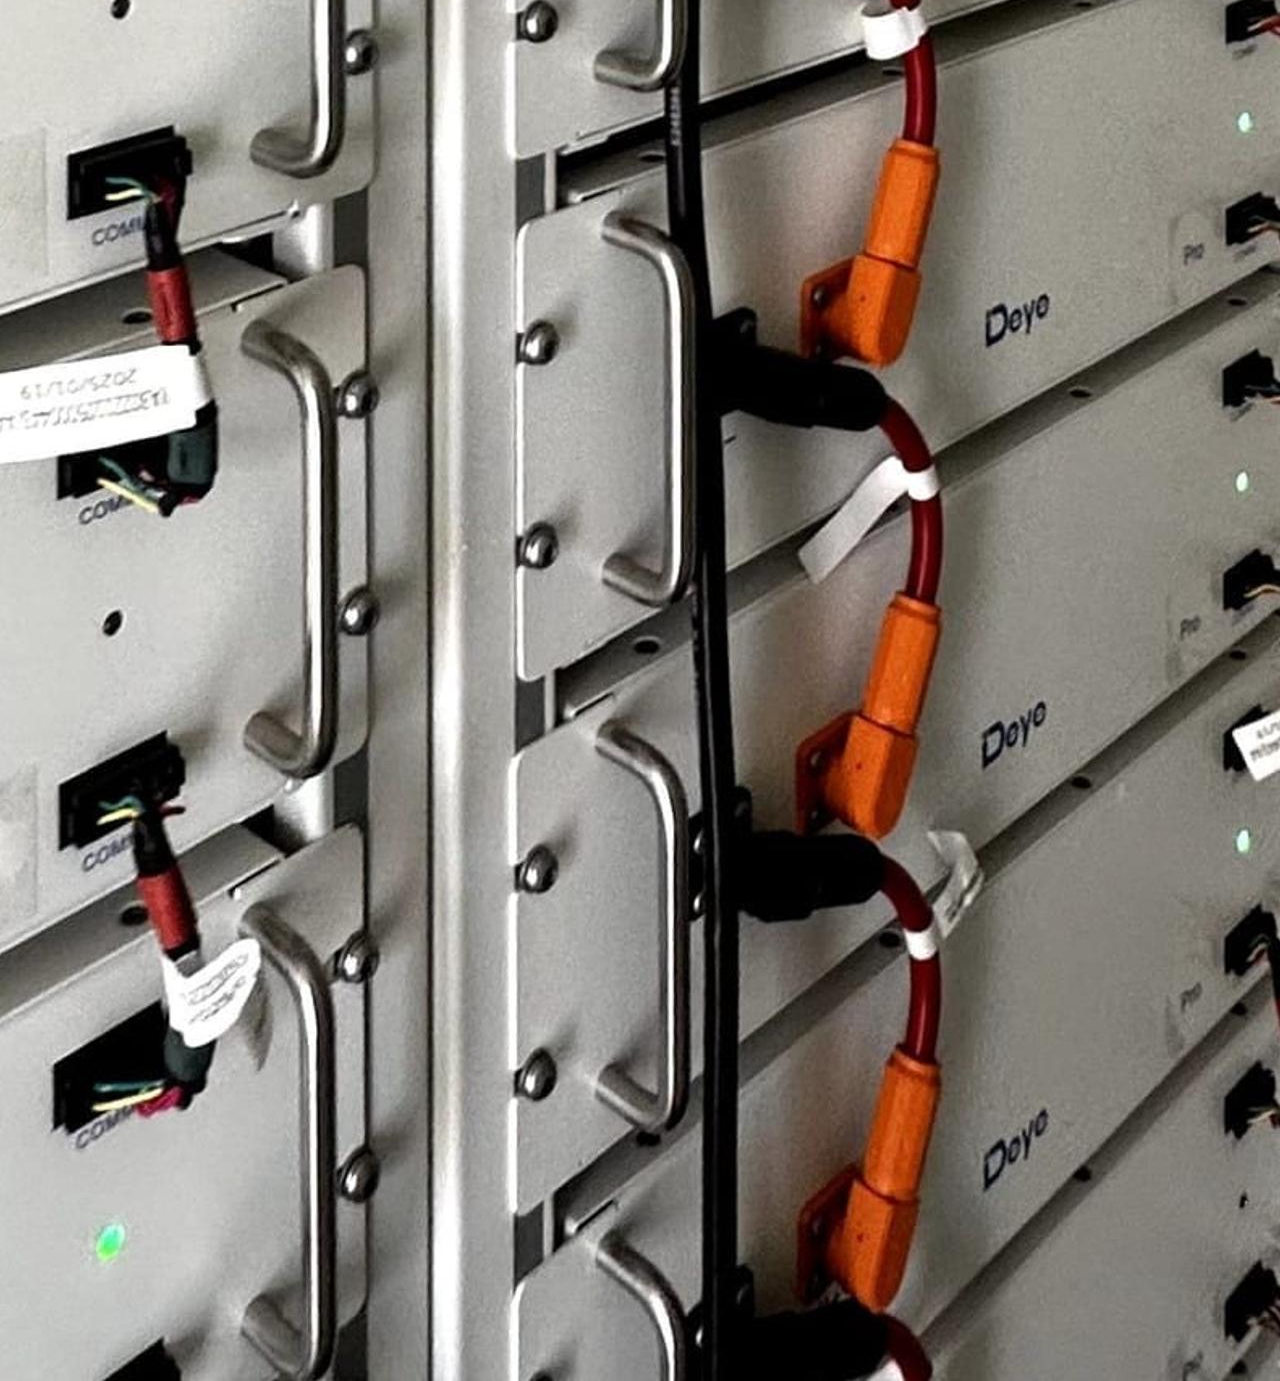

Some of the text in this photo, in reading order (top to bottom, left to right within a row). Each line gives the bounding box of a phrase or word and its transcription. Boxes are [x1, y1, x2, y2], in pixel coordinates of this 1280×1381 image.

[985, 291, 1050, 349] Deye
[981, 700, 1047, 771] Deye
[983, 1108, 1049, 1193] Deye
